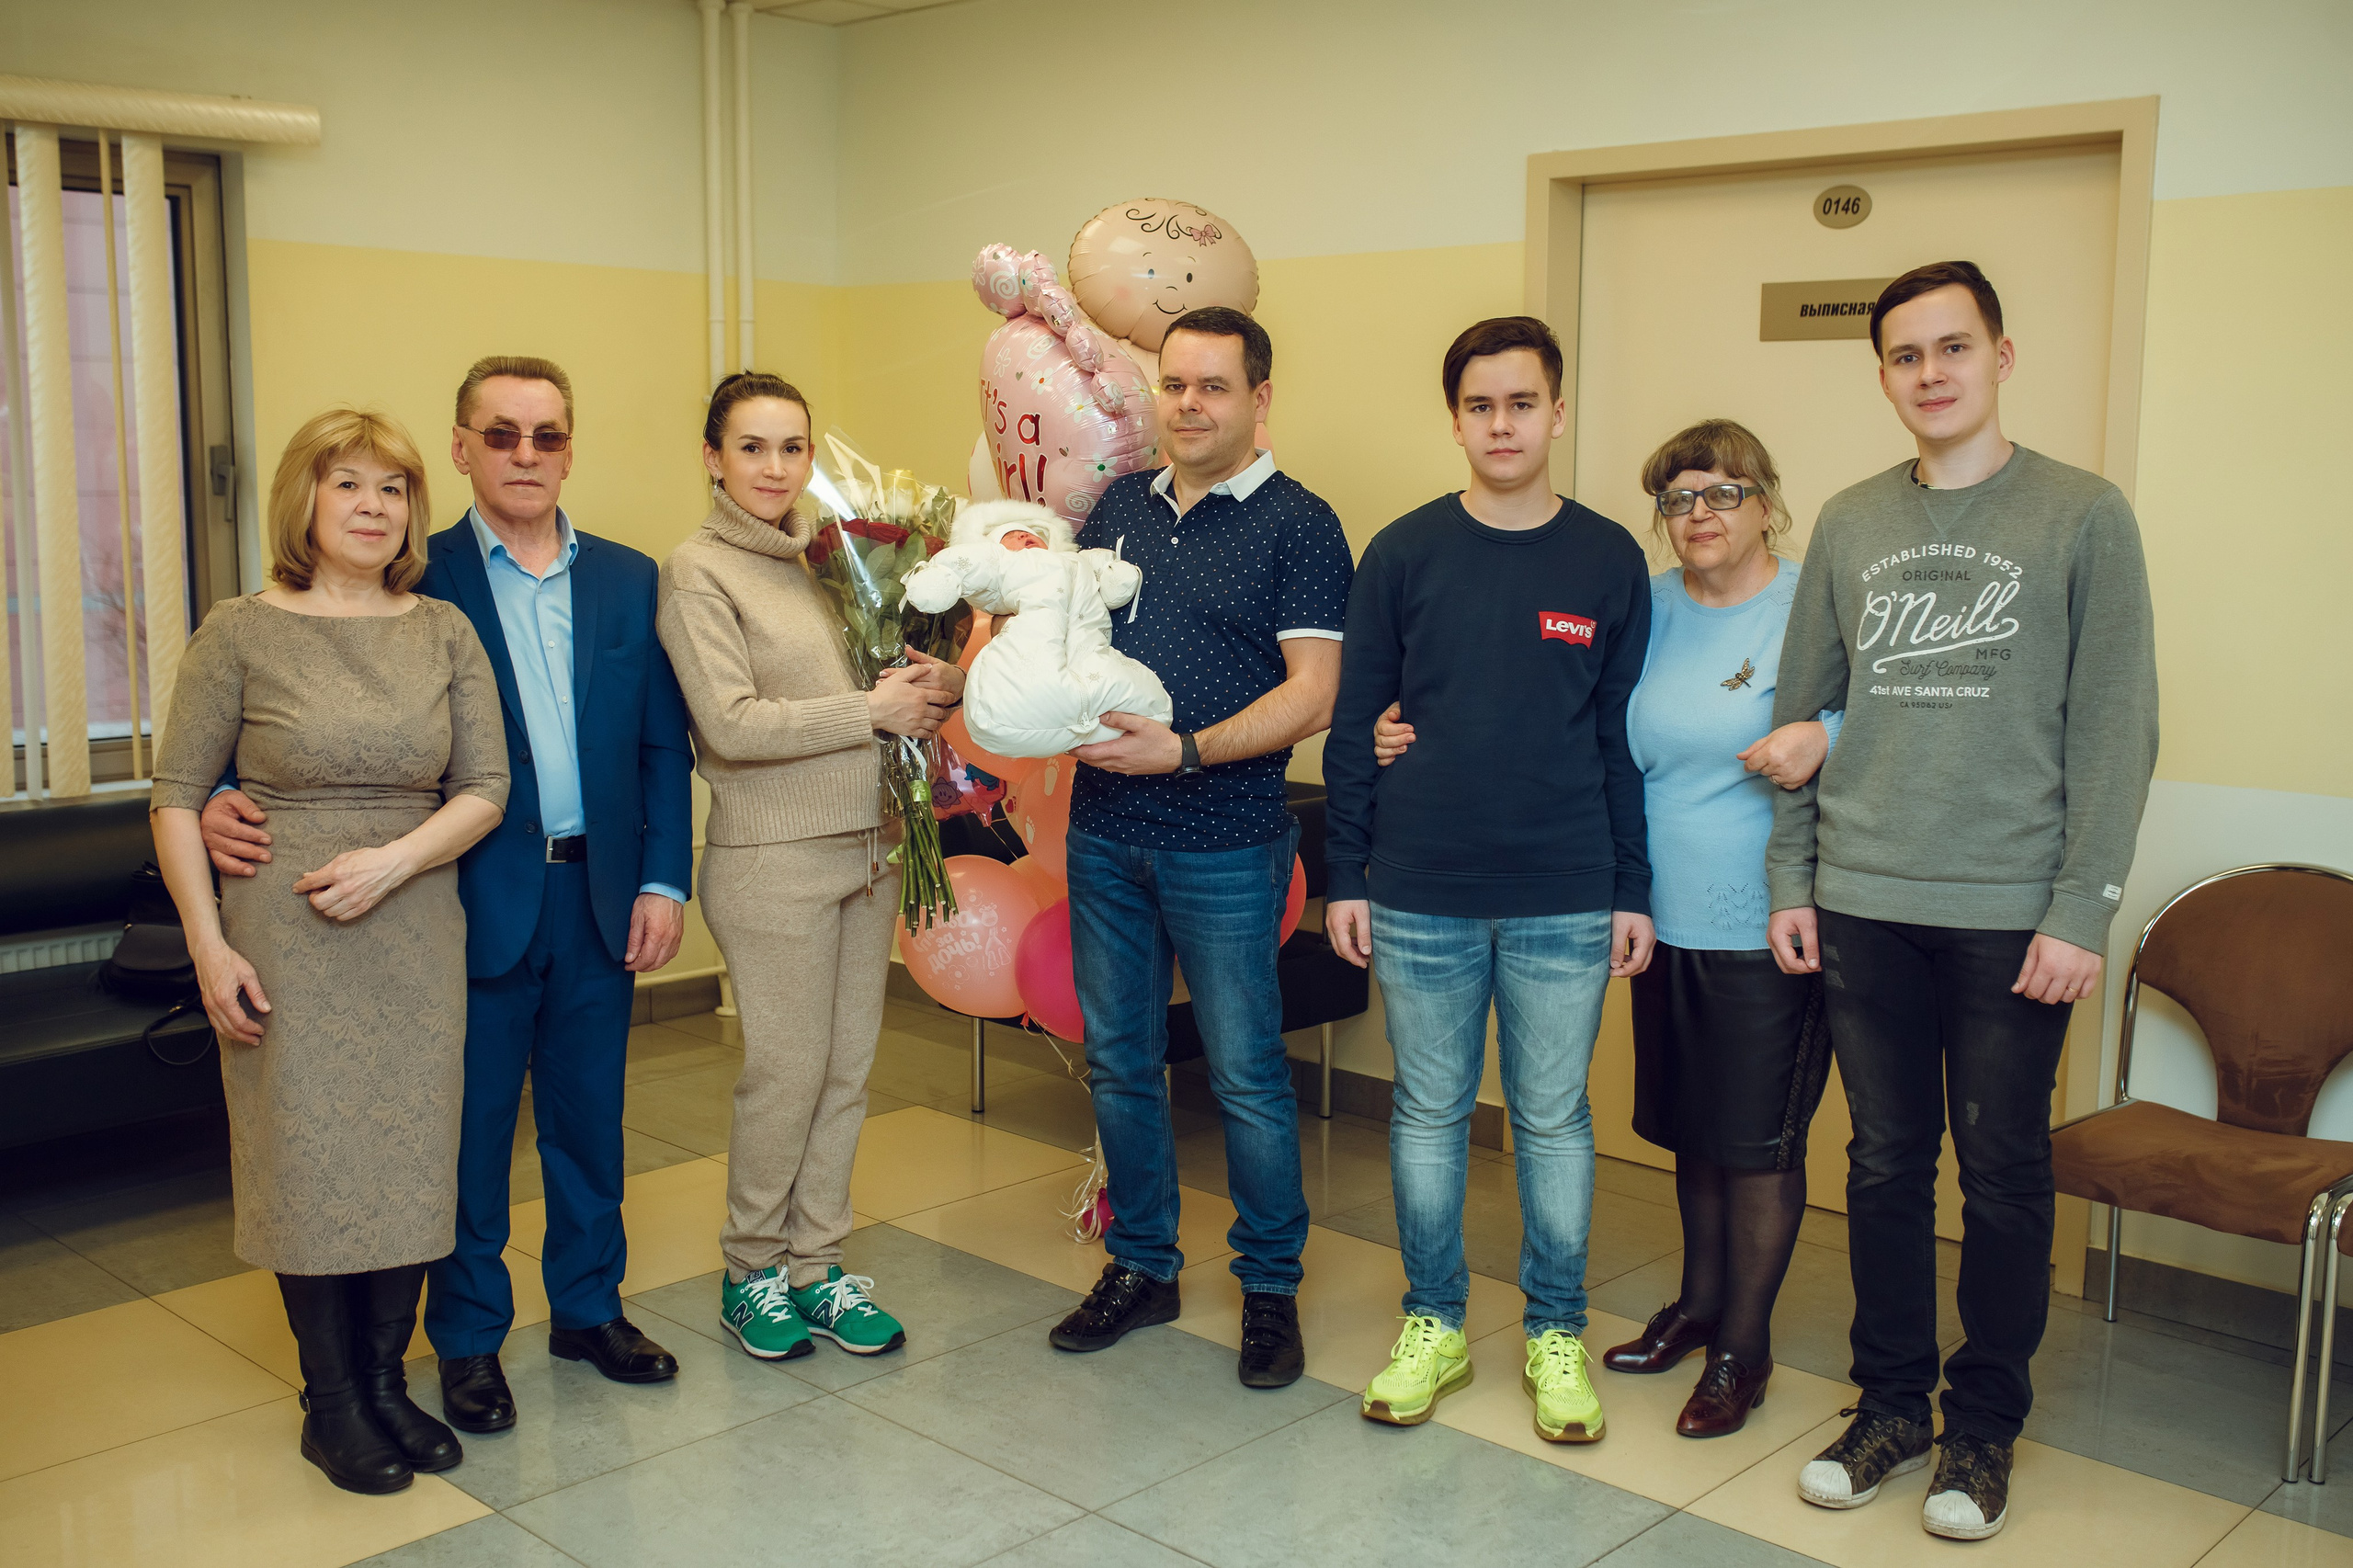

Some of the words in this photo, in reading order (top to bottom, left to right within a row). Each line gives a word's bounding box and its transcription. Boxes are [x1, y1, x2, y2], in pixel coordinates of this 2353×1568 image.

[1823, 197, 1861, 215] 0146
[1017, 413, 1040, 446] a
[1861, 543, 1976, 582] ESTABLISHED
[1983, 552, 2023, 579] 1952
[1976, 648, 2012, 661] MFG
[1900, 660, 1935, 680] Surf
[1936, 660, 1997, 681] Company
[1870, 685, 1890, 696] 41st
[1892, 686, 1912, 697] AVE
[1914, 686, 1954, 698] SANTA
[1956, 687, 1990, 698] CRUZ
